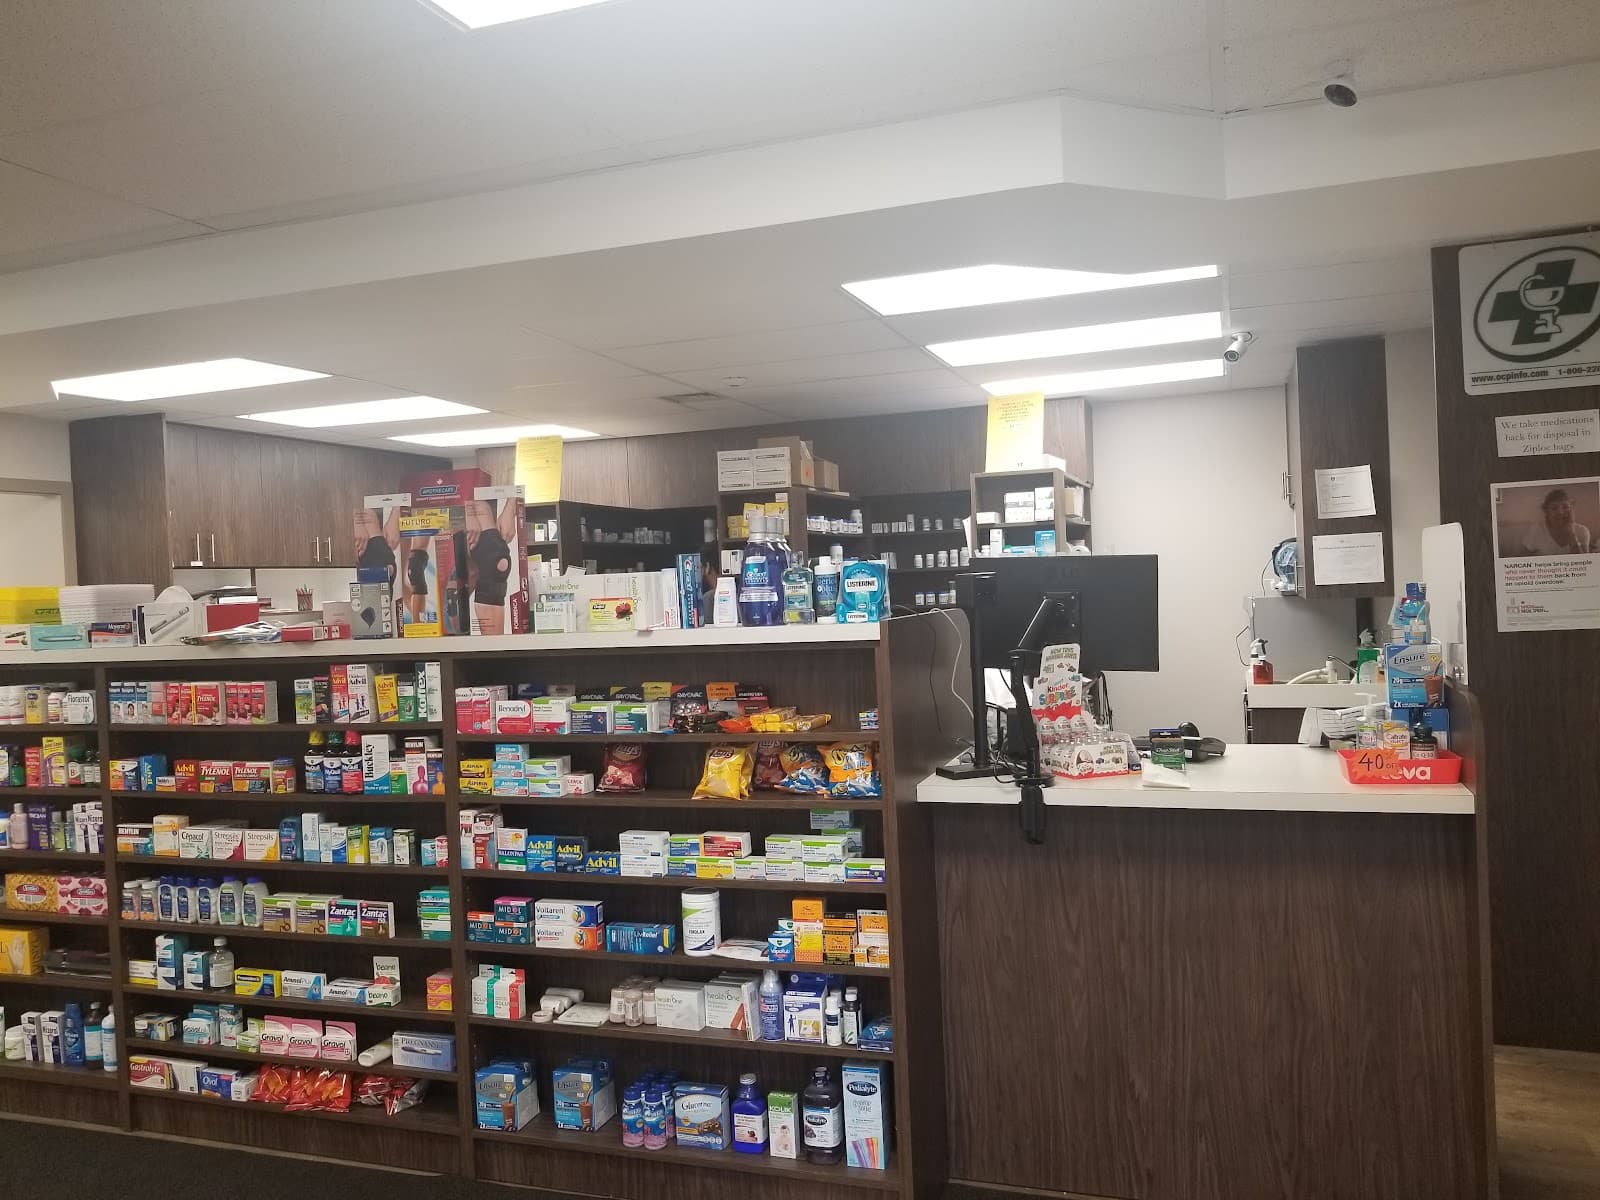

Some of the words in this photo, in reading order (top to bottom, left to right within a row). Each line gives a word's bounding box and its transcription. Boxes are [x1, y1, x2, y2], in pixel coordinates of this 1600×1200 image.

[1472, 369, 1548, 385] www.ocpinfo.com
[1501, 421, 1516, 431] We
[1519, 420, 1538, 430] take
[1540, 416, 1594, 429] medications
[1505, 434, 1525, 443] back
[1527, 433, 1541, 441] for
[1543, 430, 1579, 443] disposal
[1581, 429, 1590, 437] in
[1523, 444, 1550, 455] Ziploc
[1553, 443, 1575, 454] bags
[401, 518, 431, 527] FUTURO
[847, 580, 876, 588] LISTERINE
[1394, 654, 1425, 666] Ensure
[68, 694, 91, 703] Florastor
[417, 671, 427, 719] Koffex
[677, 691, 703, 699] RAYOVAC
[1358, 752, 1384, 772] 40
[145, 762, 154, 785] Advil
[176, 764, 195, 773] Advil
[201, 767, 230, 776] TYLENOL
[76, 815, 88, 823] Nizor
[88, 814, 103, 822] Nizora
[247, 832, 274, 842] Strepsils
[528, 840, 553, 850] Advil
[557, 844, 581, 854] Advil
[587, 858, 617, 869] Advil
[330, 906, 356, 917] Zantac
[361, 908, 387, 919] Zantac
[498, 905, 522, 915] MIDOL
[469, 922, 492, 931] MIDOL
[498, 928, 522, 936] MIDOL
[283, 976, 301, 984] Anusol
[329, 988, 347, 996] Anusol
[262, 1033, 284, 1043] Gravol
[290, 1036, 313, 1047] Gravol
[323, 1039, 346, 1049] Gravol
[130, 1062, 161, 1075] Gastrolyte
[202, 1076, 218, 1087] Ovol
[849, 1084, 878, 1094] Pedialyte
